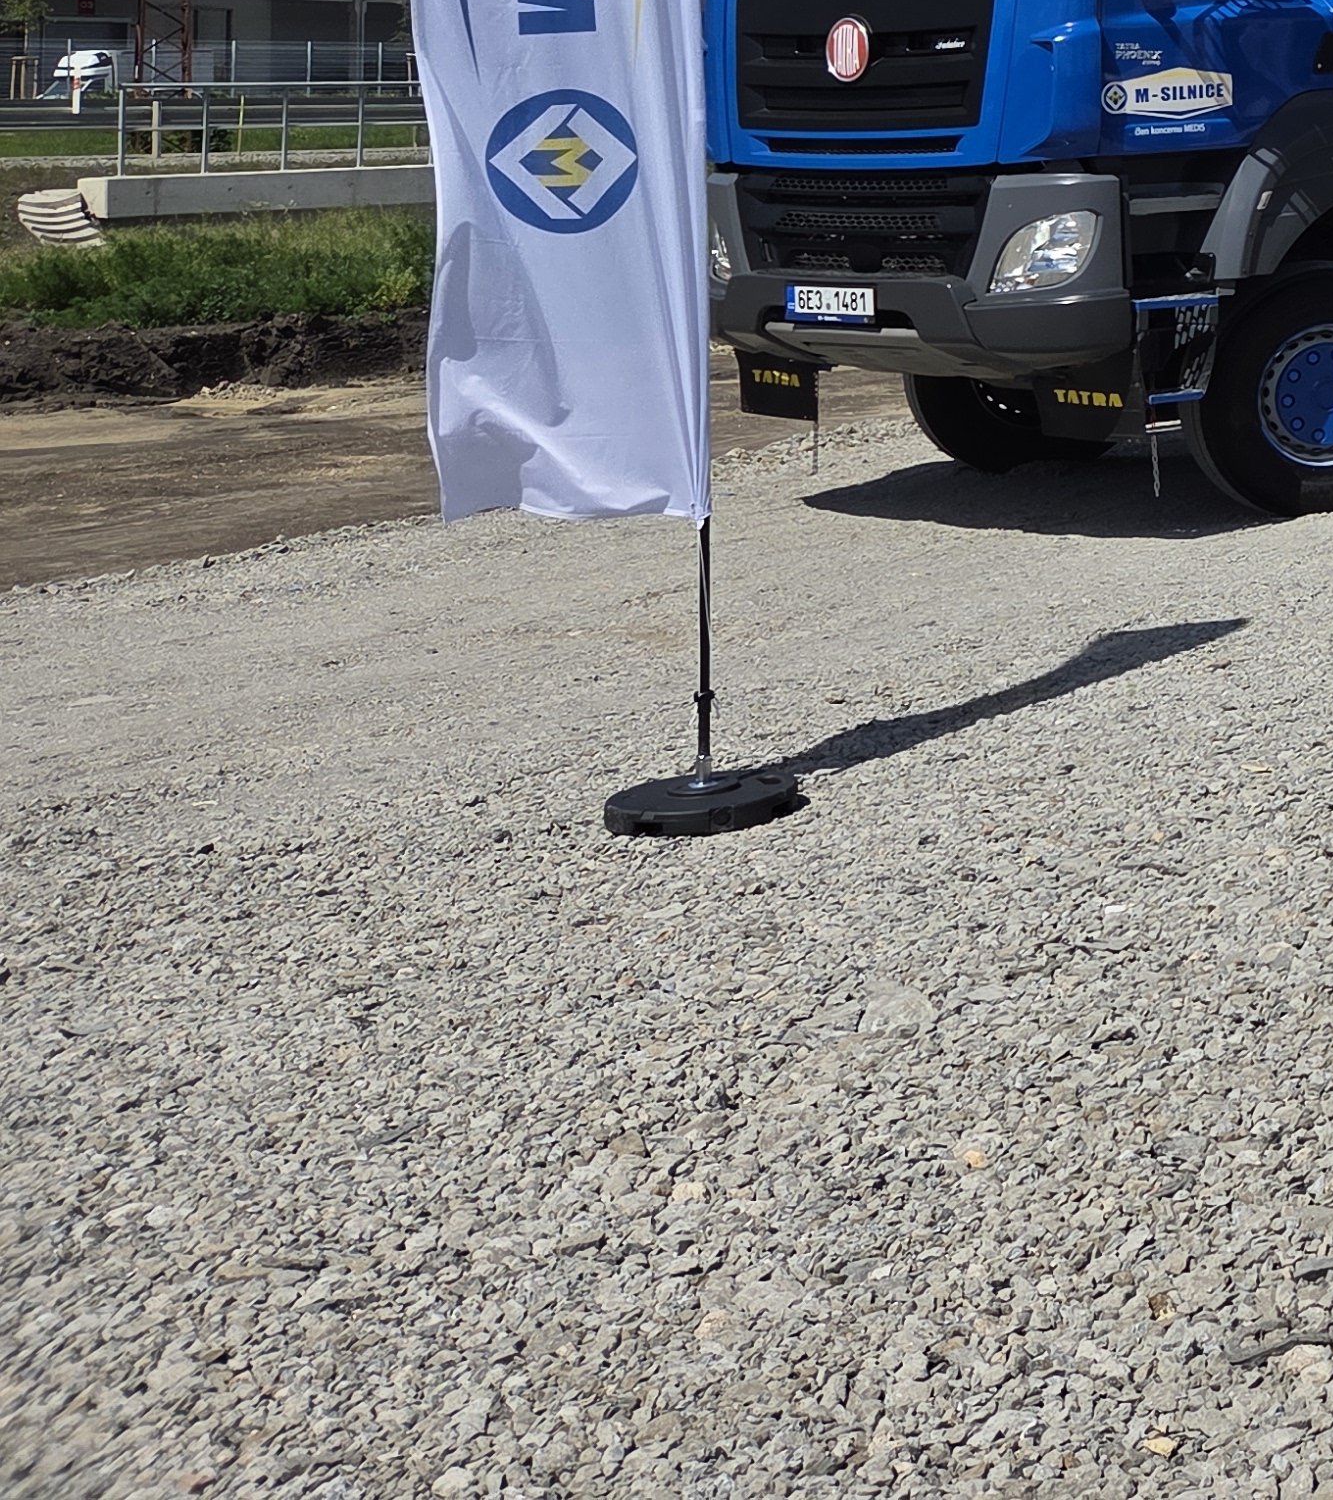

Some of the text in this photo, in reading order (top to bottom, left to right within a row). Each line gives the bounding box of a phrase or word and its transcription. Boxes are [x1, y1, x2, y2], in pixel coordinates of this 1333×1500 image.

[798, 289, 823, 310] 6E3
[833, 290, 867, 312] 1481
[752, 368, 800, 388] TATRA
[1053, 389, 1123, 408] TATRA
